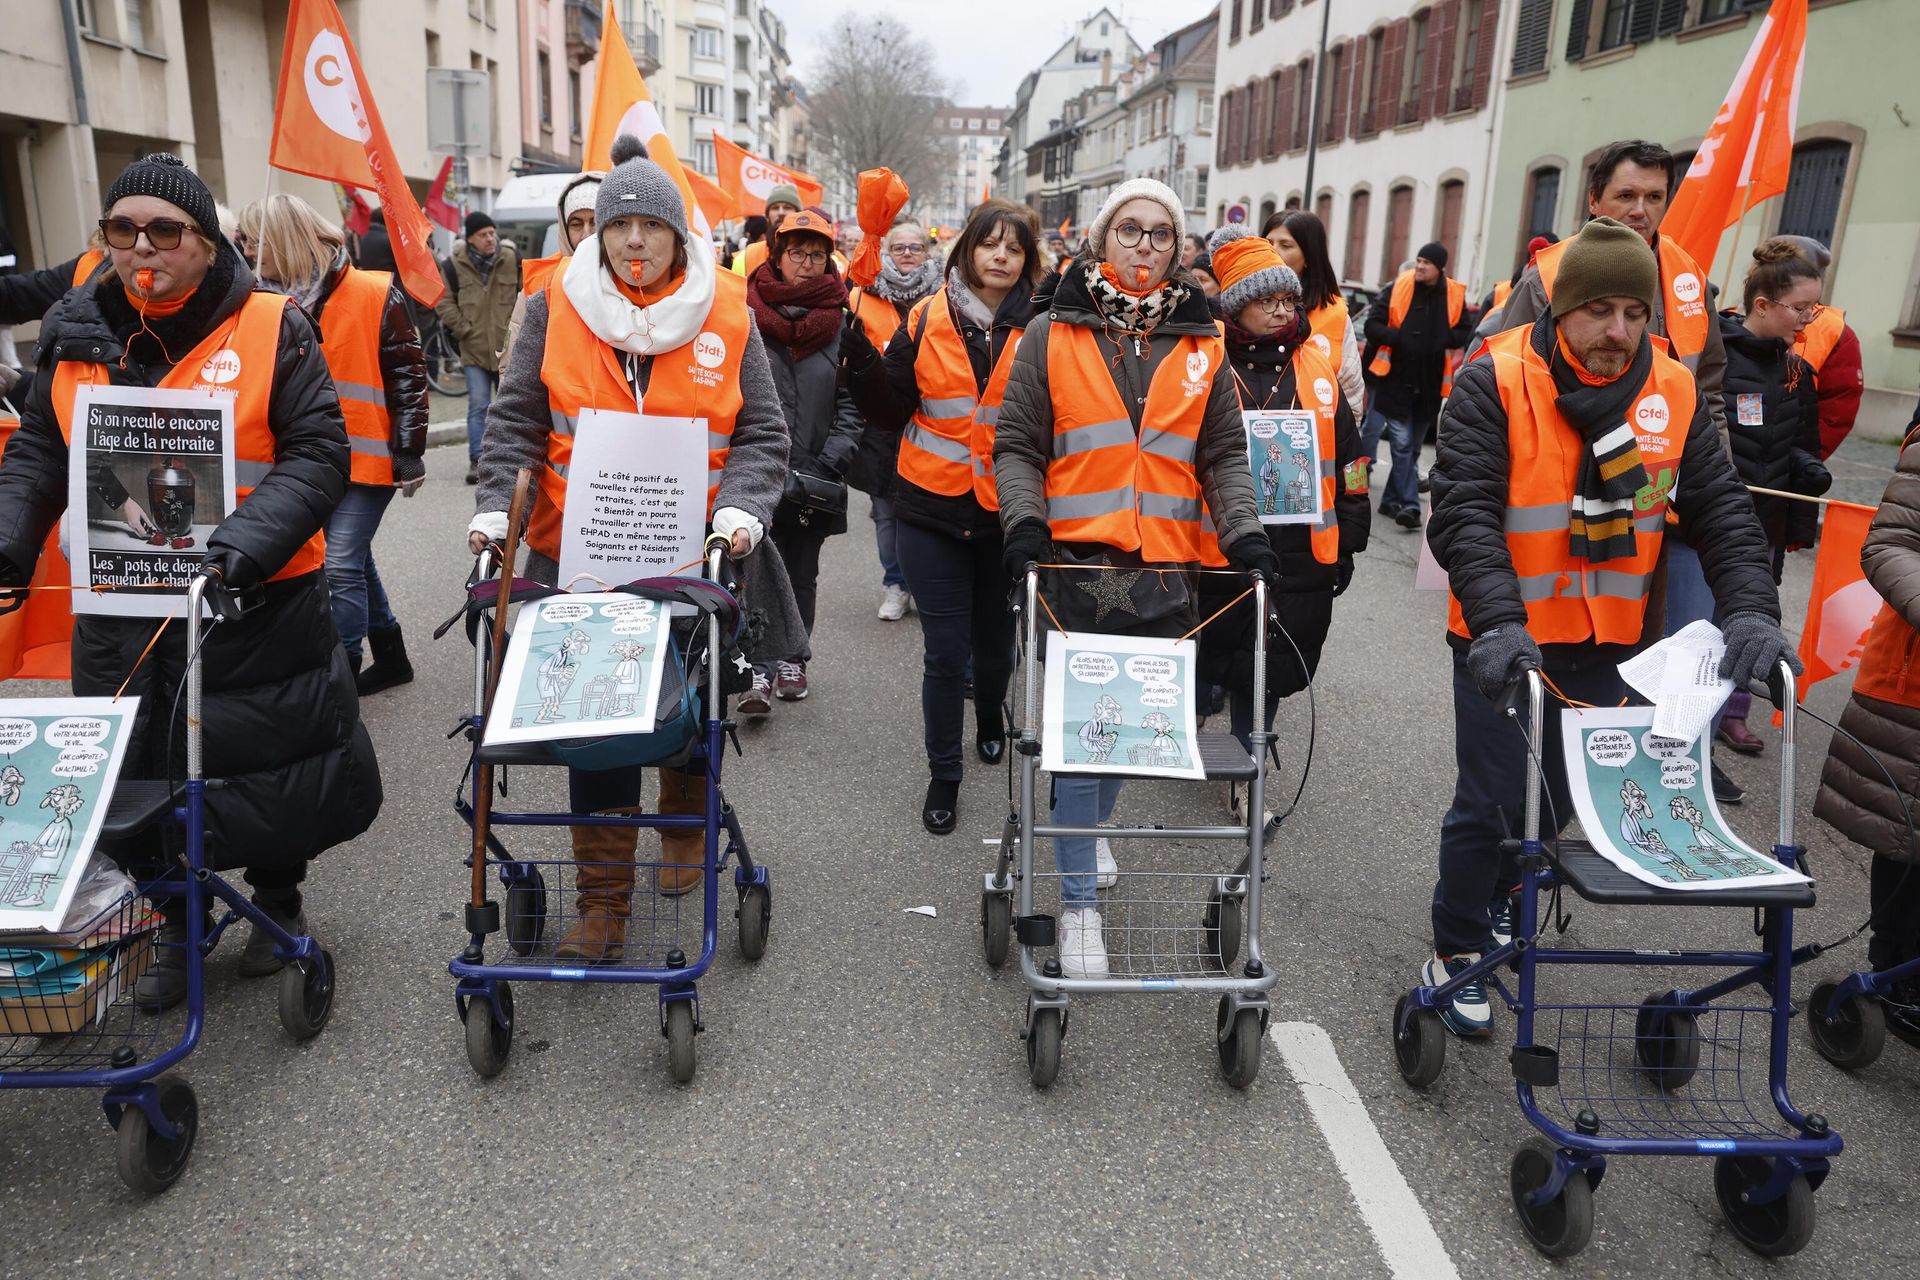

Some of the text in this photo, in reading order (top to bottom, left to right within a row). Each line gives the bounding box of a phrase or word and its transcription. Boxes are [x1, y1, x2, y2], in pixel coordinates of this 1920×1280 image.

[90, 408, 220, 431] Si on recule encore
[93, 429, 215, 453] l'âge de la retraite
[1636, 434, 1652, 444] ANTÉ
[599, 470, 678, 484] Le côté positif des
[590, 482, 627, 492] nouvelles
[630, 486, 667, 495] réformes
[595, 495, 636, 506] retraites,
[604, 507, 634, 516] Bientôt
[591, 518, 629, 527] travailler
[580, 527, 610, 538] EHPAD
[627, 532, 650, 540] même
[653, 534, 677, 543] temps
[585, 540, 625, 551] Soignants
[641, 544, 679, 552] Résidents
[607, 554, 632, 563] pierre
[644, 557, 666, 565] coups
[93, 554, 113, 570] Les
[125, 560, 151, 577] pots
[154, 558, 169, 573] de
[172, 558, 202, 579] dépa
[92, 571, 194, 590] risquent de chan
